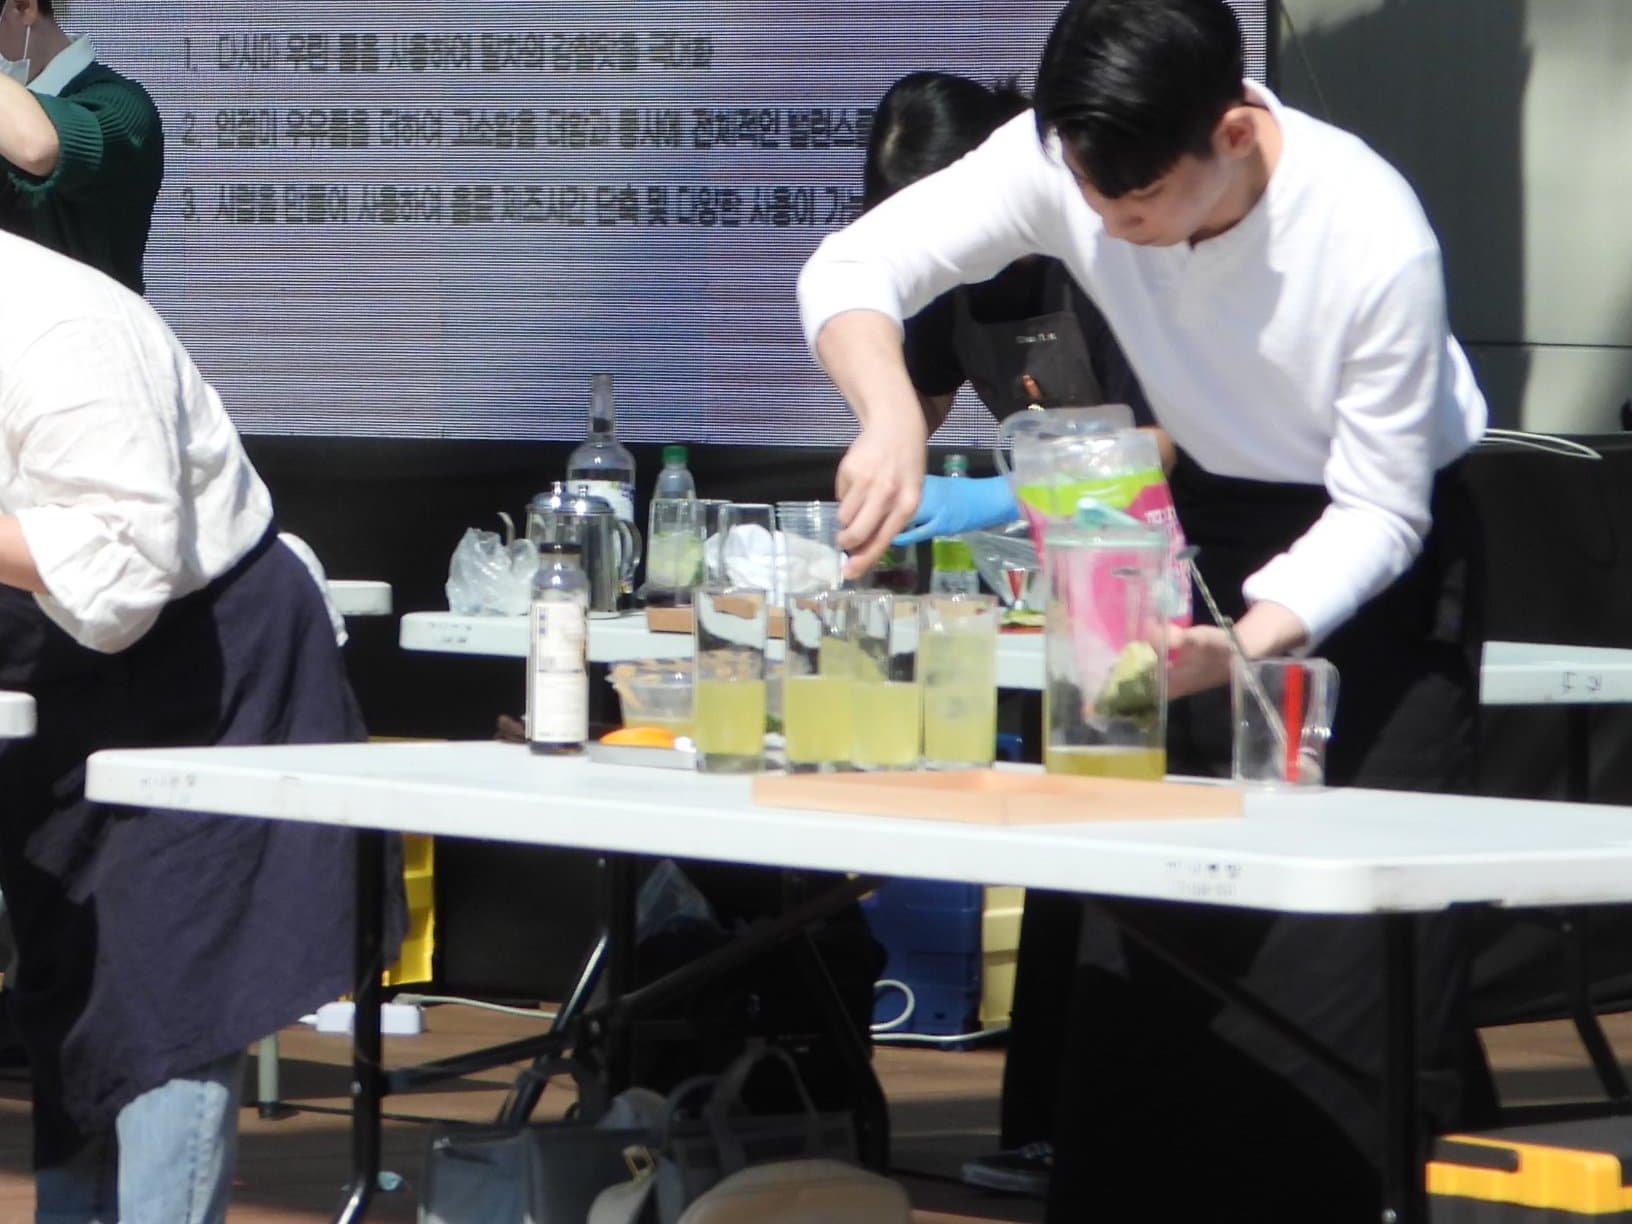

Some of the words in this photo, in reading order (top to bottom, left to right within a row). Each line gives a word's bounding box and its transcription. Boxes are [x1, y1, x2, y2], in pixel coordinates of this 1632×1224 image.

[184, 35, 198, 73] 1.
[218, 33, 279, 72] 다시마
[286, 32, 329, 73] 우린
[338, 32, 380, 73] 물을
[388, 32, 473, 73] 사용하여
[481, 32, 545, 73] 말차의
[552, 31, 640, 73] 감칠맛을
[648, 30, 715, 70] 극대화
[182, 111, 202, 149] 2.
[215, 107, 278, 149] 인절미
[379, 107, 443, 148] 더하여
[451, 107, 537, 150] 고소함을
[547, 107, 612, 149] 더함과
[619, 107, 684, 149] 동시에
[691, 107, 780, 150] 전체적인
[181, 186, 201, 224] 3.
[216, 184, 277, 225] 시럽을
[284, 184, 348, 225] 만들어
[357, 184, 442, 225] 사용하여
[452, 184, 494, 225] 음료
[500, 184, 588, 226] 제조시간
[596, 183, 640, 227] 단축
[646, 184, 668, 227] 및
[677, 184, 743, 227] 다양한
[749, 185, 815, 227] 사용이
